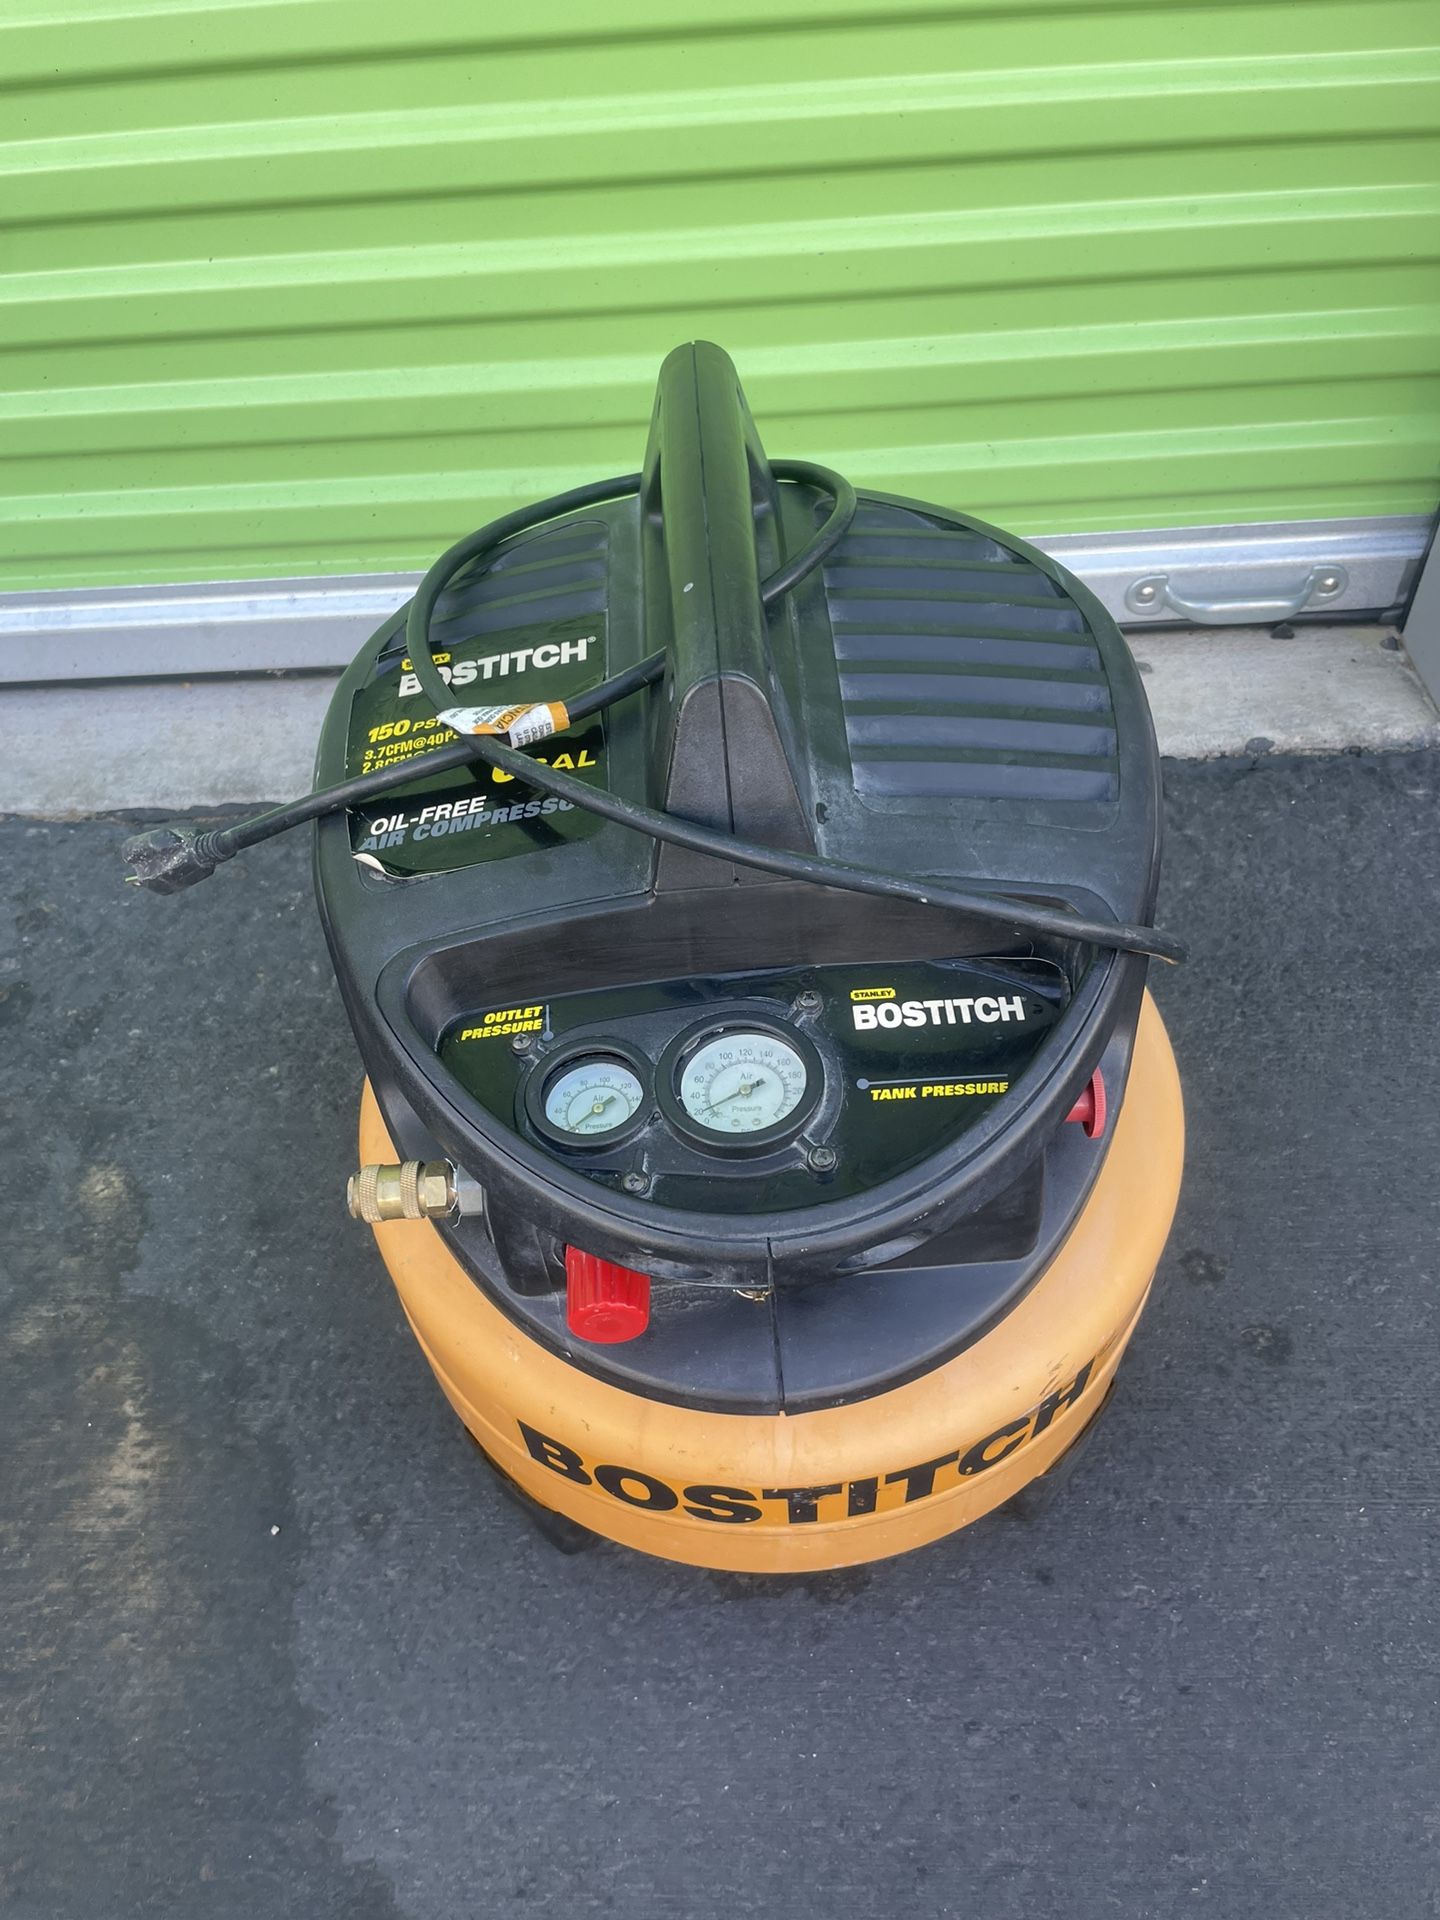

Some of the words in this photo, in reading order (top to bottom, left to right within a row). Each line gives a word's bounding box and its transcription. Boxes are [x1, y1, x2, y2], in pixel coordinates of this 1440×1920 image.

[368, 719, 411, 743] 150
[364, 730, 460, 760] 3.7CFM@40P
[358, 830, 404, 851] AIR
[412, 797, 575, 841] COMPRESSO
[370, 795, 487, 836] OIL-FREE
[853, 989, 892, 999] STANLEY
[484, 1005, 544, 1025] OUTLET
[852, 995, 1026, 1030] BOSTITCH
[461, 1018, 543, 1041] PRESSURE
[719, 1052, 733, 1060] 100
[739, 1048, 753, 1056] 120
[760, 1050, 773, 1058] 140
[694, 1076, 705, 1084] 60
[740, 1072, 753, 1081] Air
[690, 1091, 701, 1100] 40
[871, 1086, 917, 1101] TANK
[921, 1081, 1009, 1098] PRESSURE
[517, 1358, 1097, 1524] BOSTITCH
